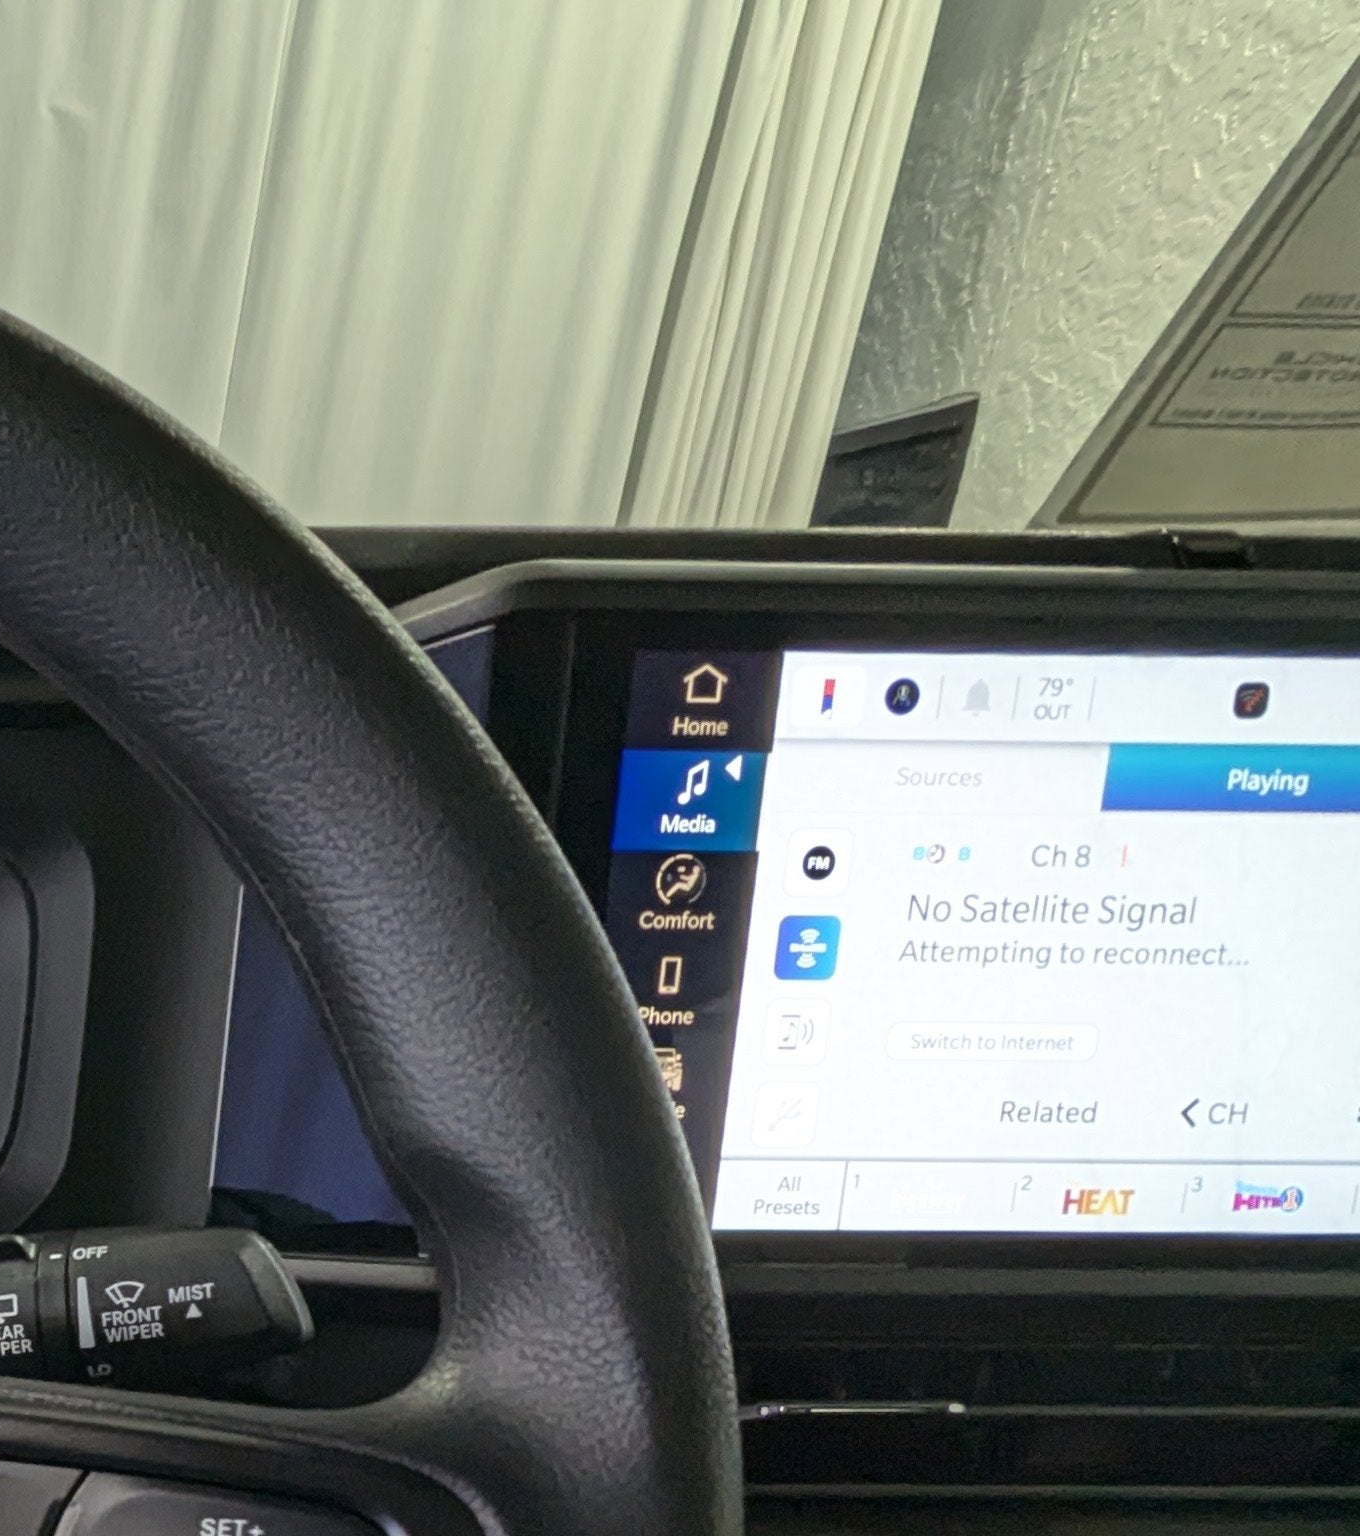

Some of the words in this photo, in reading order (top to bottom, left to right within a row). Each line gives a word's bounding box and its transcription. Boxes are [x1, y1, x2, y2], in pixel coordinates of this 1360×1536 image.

[1037, 677, 1074, 698] 79°
[1034, 705, 1071, 721] OUT
[672, 717, 728, 736] Home
[895, 767, 983, 787] Sources
[1227, 768, 1309, 797] Playing
[660, 814, 715, 834] Media
[806, 857, 831, 870] FM
[1031, 844, 1067, 868] Ch
[1075, 845, 1091, 868] 8
[639, 910, 714, 931] Comfort
[908, 894, 951, 923] No
[961, 894, 1090, 924] Satellite
[1098, 896, 1197, 931] Signal
[899, 940, 1051, 969] Attempting
[1060, 943, 1084, 965] to
[1093, 943, 1250, 967] reconnect...
[639, 1006, 695, 1025] Phone
[909, 1031, 973, 1051] Switch
[976, 1034, 997, 1051] to
[1002, 1033, 1073, 1052] Internet
[1000, 1101, 1097, 1125] Related
[1208, 1103, 1248, 1125] CH
[777, 1176, 801, 1192] All
[853, 1174, 861, 1189] 1
[1021, 1175, 1032, 1191] 2
[1191, 1176, 1203, 1192] 3
[753, 1199, 820, 1216] Presets
[1062, 1188, 1135, 1215] HEAT
[72, 1245, 108, 1261] OFF
[168, 1282, 215, 1304] MIST
[101, 1305, 163, 1326] FRONT
[104, 1323, 165, 1344] WIPER
[87, 1363, 112, 1378] LO
